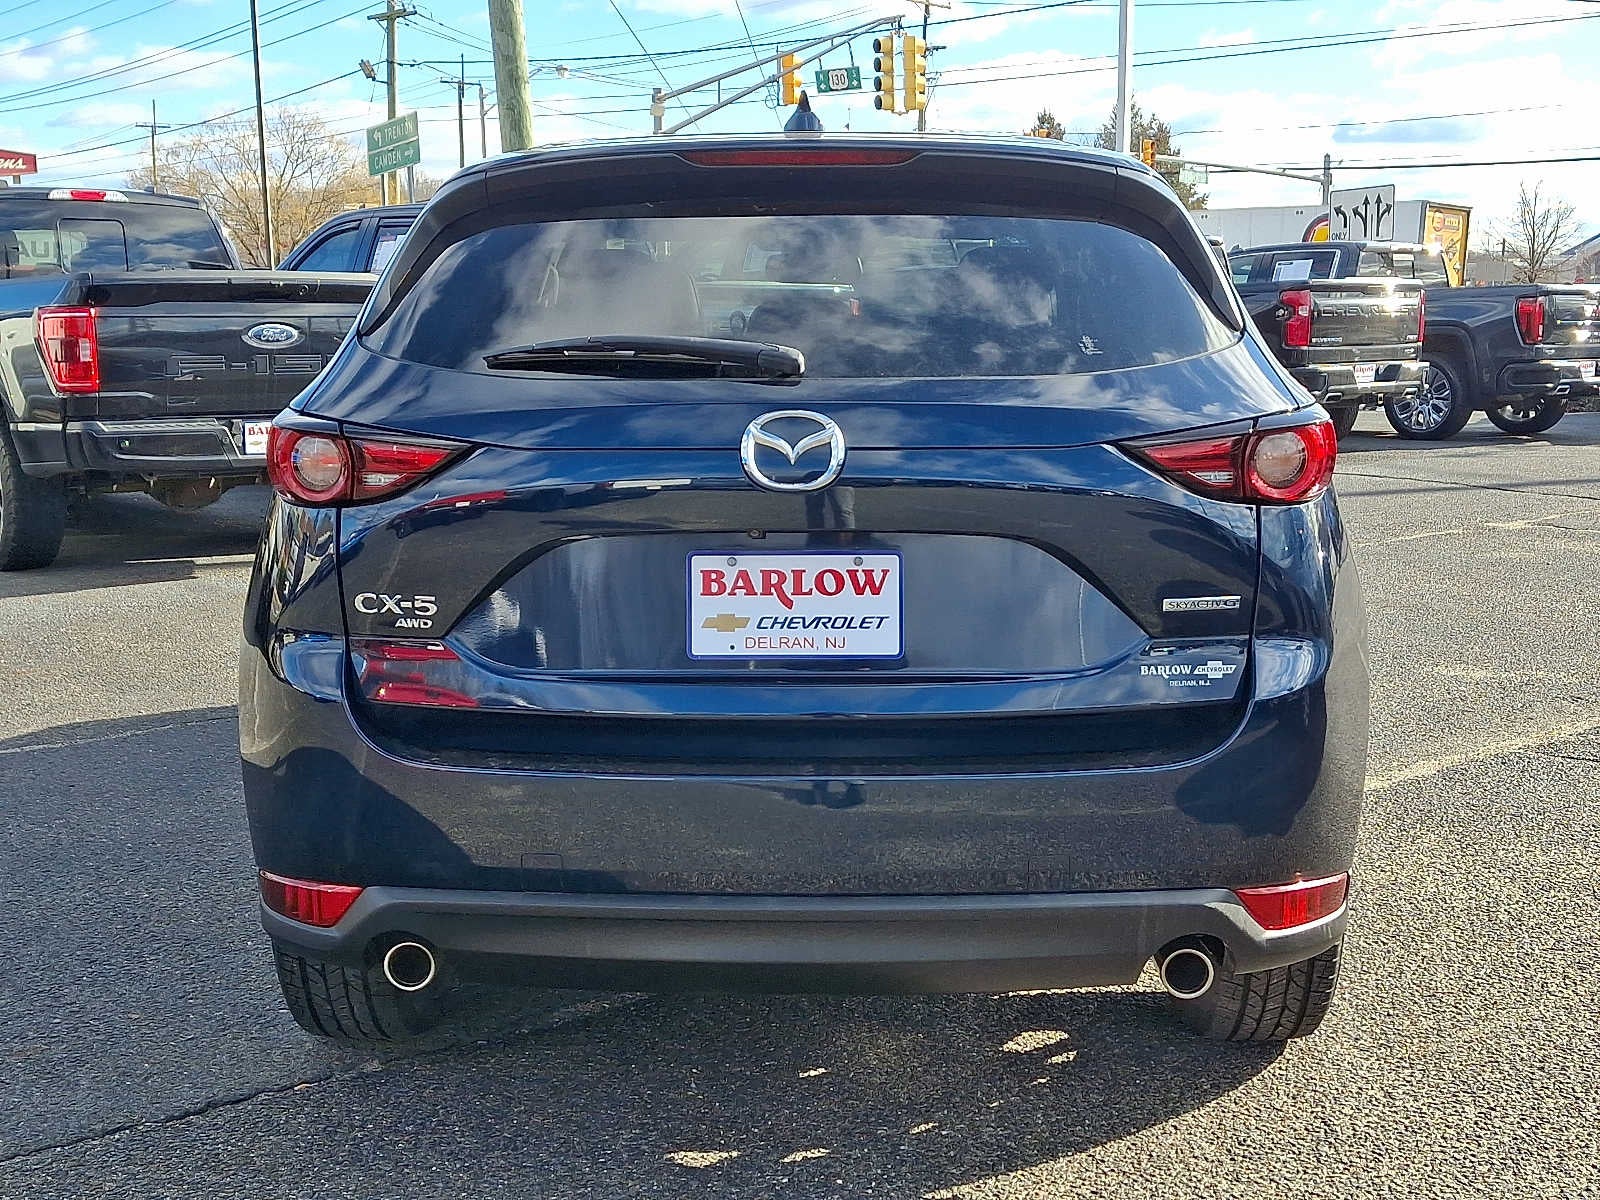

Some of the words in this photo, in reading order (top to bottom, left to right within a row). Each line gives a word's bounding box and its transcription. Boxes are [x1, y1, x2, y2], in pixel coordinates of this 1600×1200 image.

[831, 73, 845, 86] 130
[384, 119, 413, 142] TRENTON
[374, 149, 401, 170] CAMDEN
[1331, 231, 1347, 241] ONLY
[260, 328, 288, 341] Ford
[165, 354, 334, 377] F-15
[699, 568, 890, 610] BARLOW
[354, 592, 438, 616] CX-5
[394, 618, 433, 629] AWD
[756, 616, 890, 630] CHEVROLET
[744, 636, 819, 651] DELRAN,
[825, 636, 846, 650] NJ
[1140, 664, 1192, 679] BARLOW
